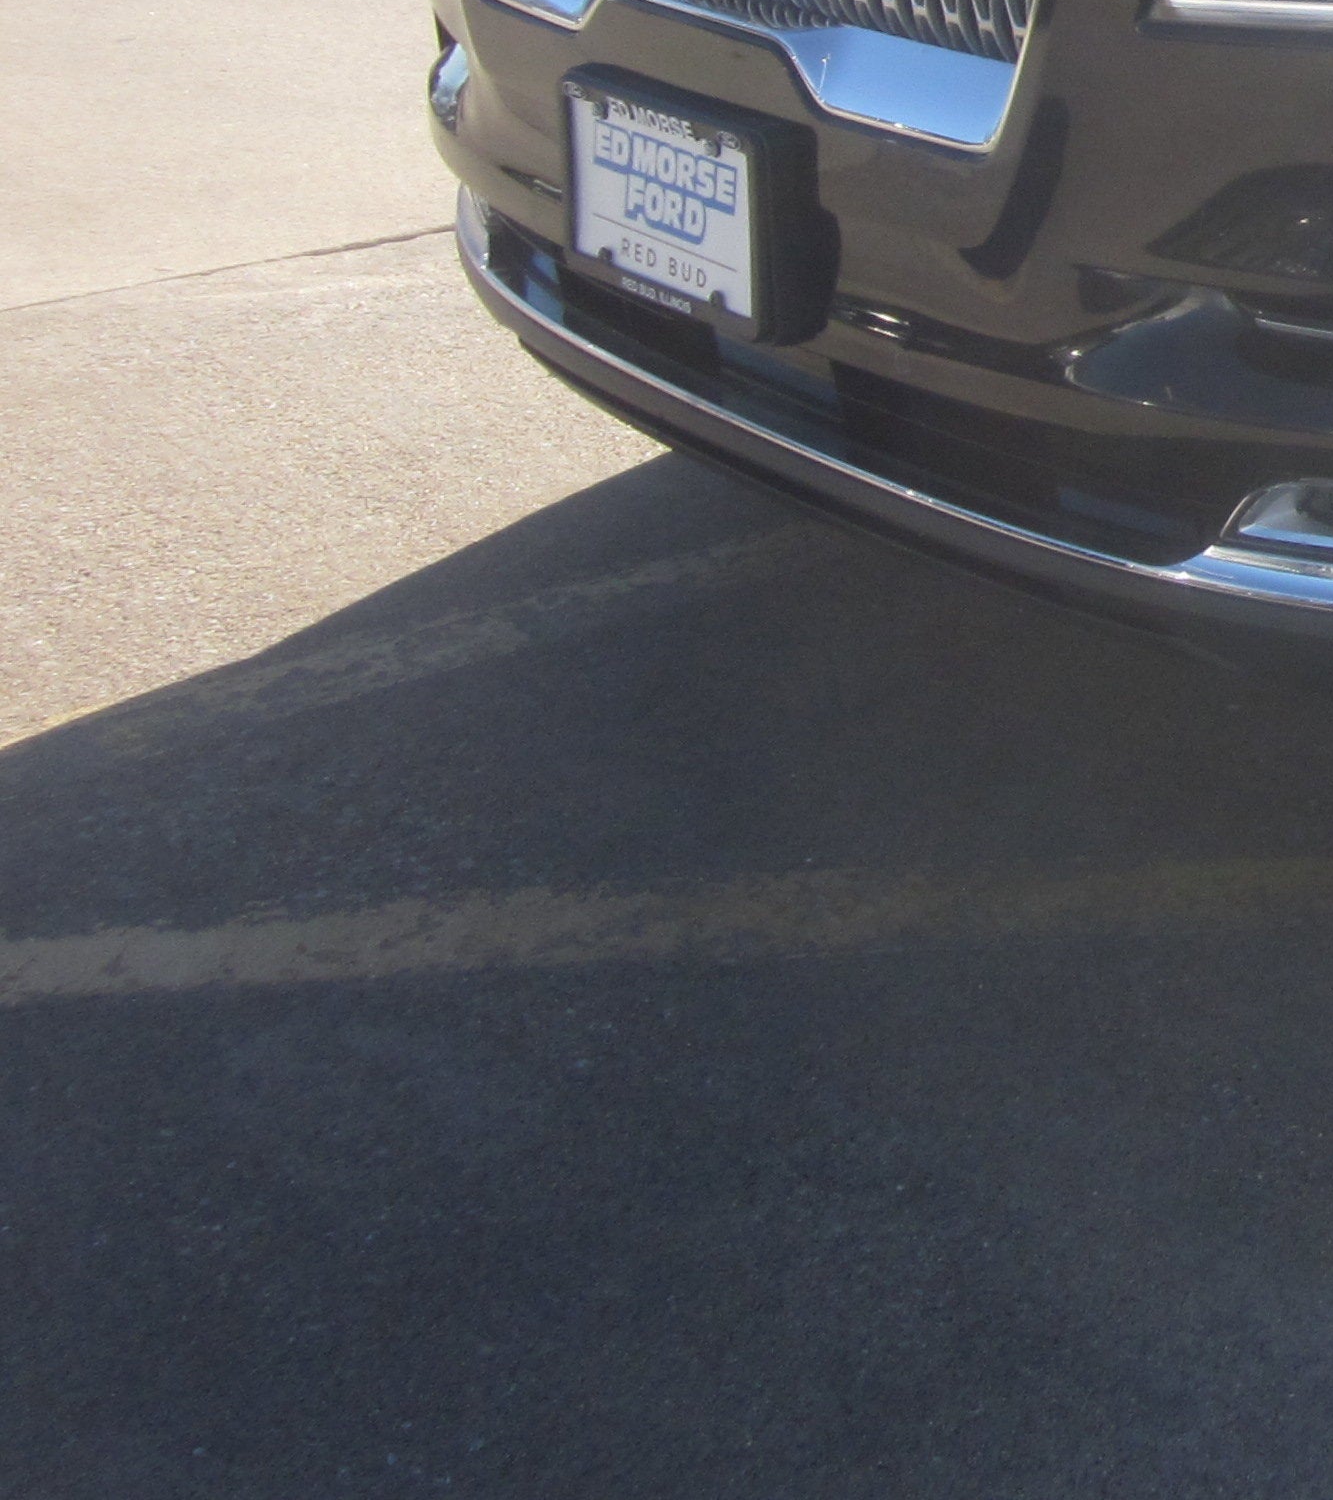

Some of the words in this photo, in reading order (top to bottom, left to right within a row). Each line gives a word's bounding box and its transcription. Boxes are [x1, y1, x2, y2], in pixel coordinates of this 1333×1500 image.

[606, 96, 630, 120] ED
[630, 104, 694, 140] MORSE
[594, 121, 630, 169] ED
[631, 133, 737, 214] MORSE
[625, 175, 706, 244] FORD
[621, 238, 656, 268] RED
[669, 257, 707, 288] BUD
